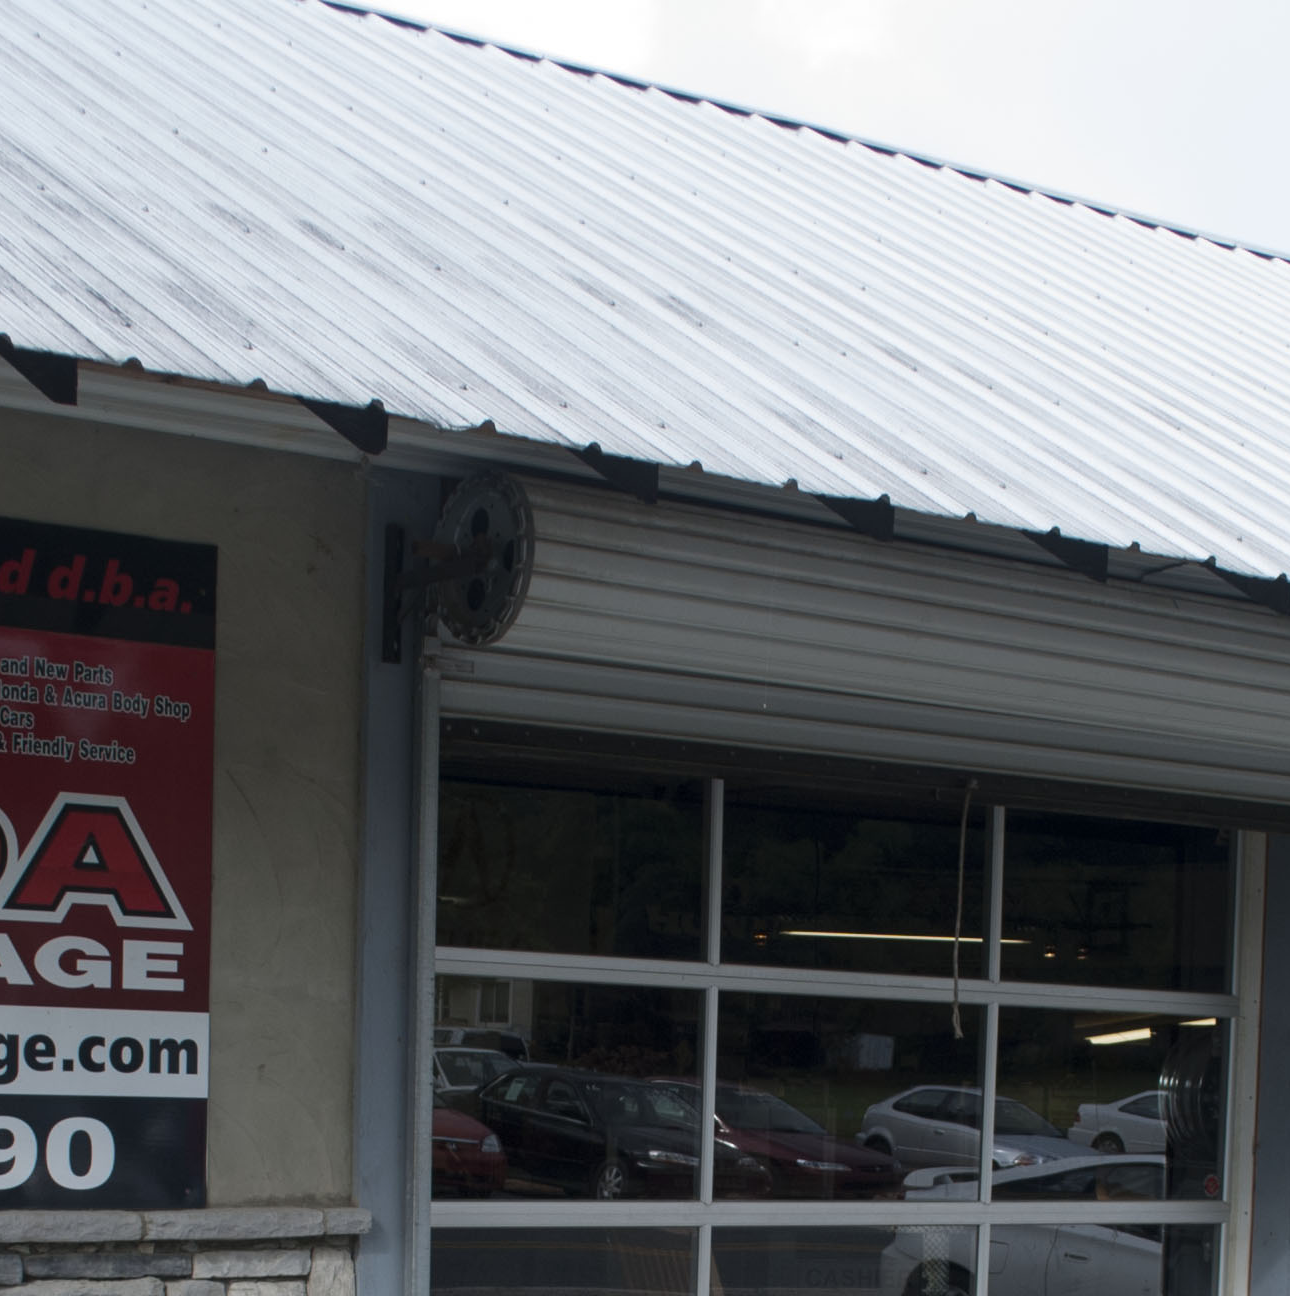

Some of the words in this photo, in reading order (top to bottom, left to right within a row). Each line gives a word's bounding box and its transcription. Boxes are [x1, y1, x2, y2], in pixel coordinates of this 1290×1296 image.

[47, 555, 193, 615] d.b.a.
[0, 656, 29, 677] and
[34, 657, 68, 681] New
[74, 661, 113, 686] Parts
[0, 706, 34, 729] Cars
[44, 685, 56, 704] &
[62, 686, 108, 711] Acura
[112, 691, 149, 719] Body
[154, 695, 191, 722] Shop
[12, 733, 73, 762] Friendly
[79, 738, 135, 764] Service
